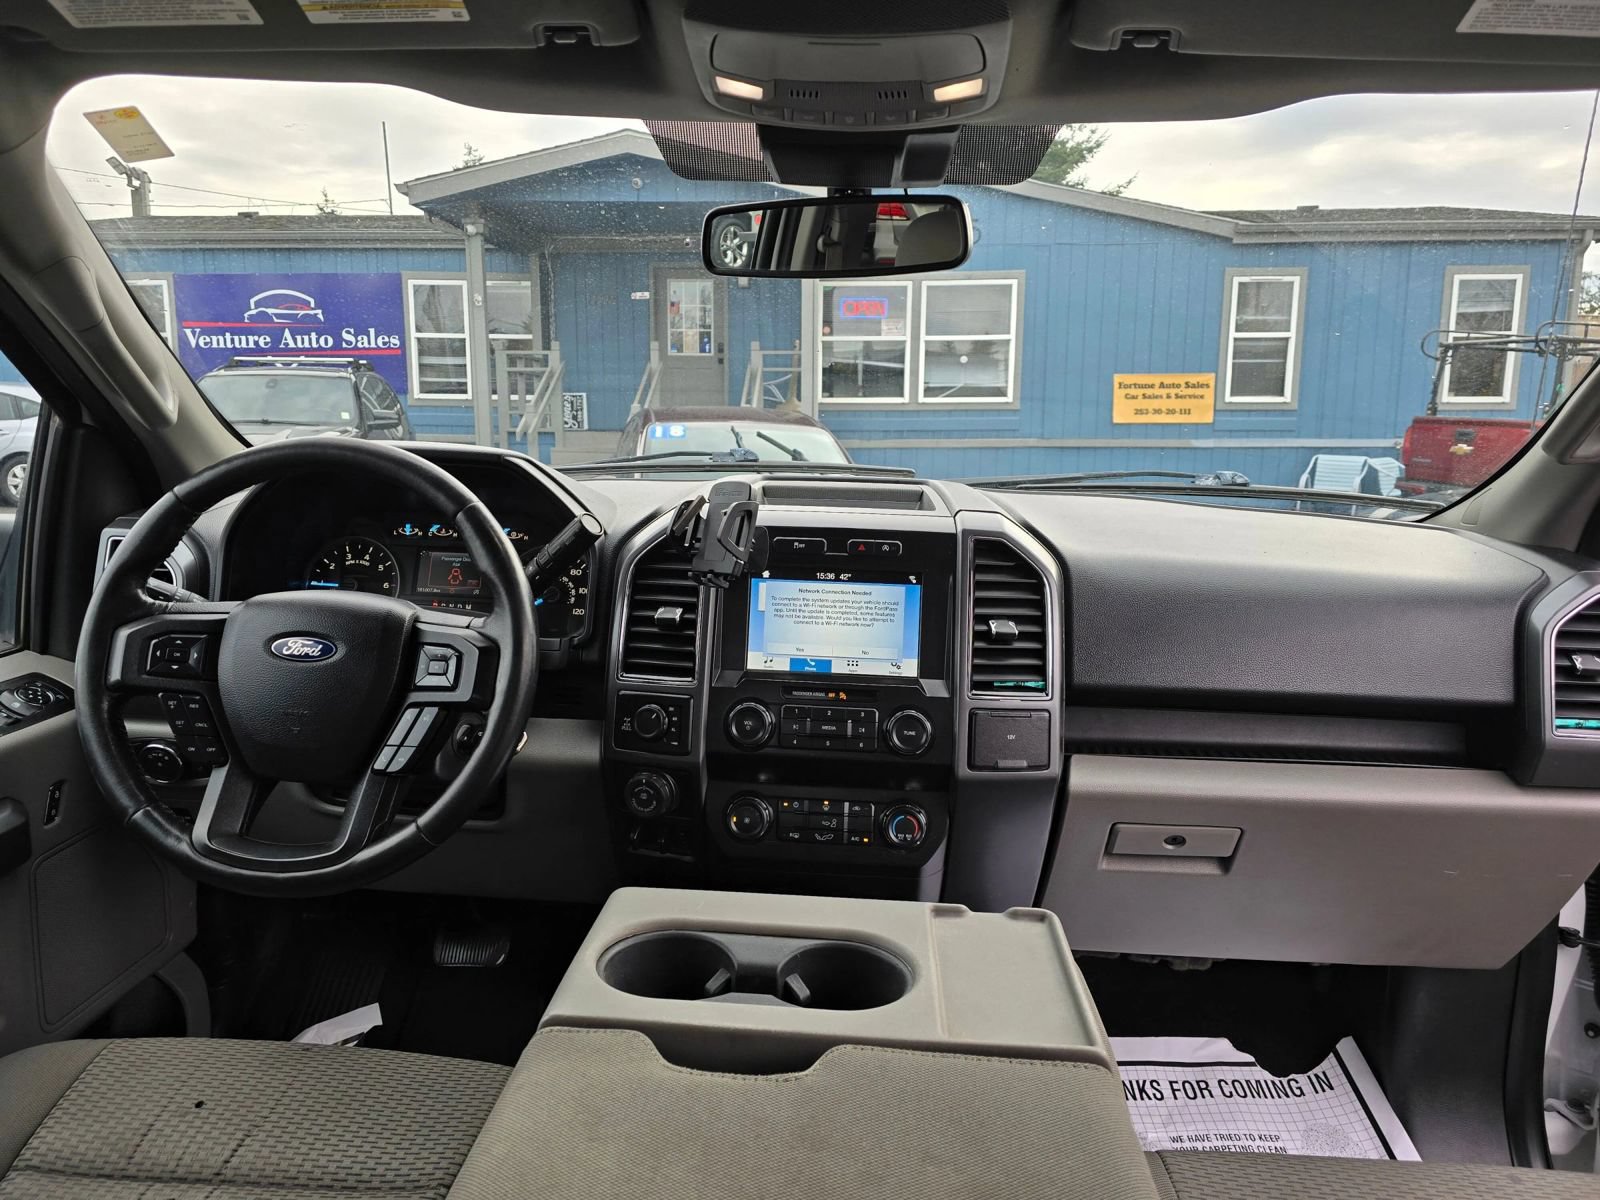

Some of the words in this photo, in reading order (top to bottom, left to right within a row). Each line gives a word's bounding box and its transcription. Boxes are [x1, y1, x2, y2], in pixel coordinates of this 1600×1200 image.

[843, 301, 885, 316] OPEN
[183, 328, 272, 349] Venture
[279, 328, 334, 348] Auto
[342, 328, 401, 348] Sales
[1118, 381, 1156, 389] Fortune
[1158, 381, 1182, 389] Auto
[1184, 381, 1210, 389] Sales
[816, 572, 835, 580] 15:36
[283, 639, 323, 656] Ford
[1122, 1079, 1164, 1100] NKS
[1169, 1079, 1214, 1100] FOR
[1217, 1077, 1306, 1099] COMING
[1307, 1071, 1335, 1094] IN
[1169, 1135, 1186, 1144] WE
[1186, 1134, 1212, 1143] HAVE
[1213, 1133, 1241, 1142] TRIED
[1242, 1133, 1256, 1142] TO
[1257, 1134, 1281, 1143] KEEP
[1256, 1145, 1288, 1154] CLEAN
